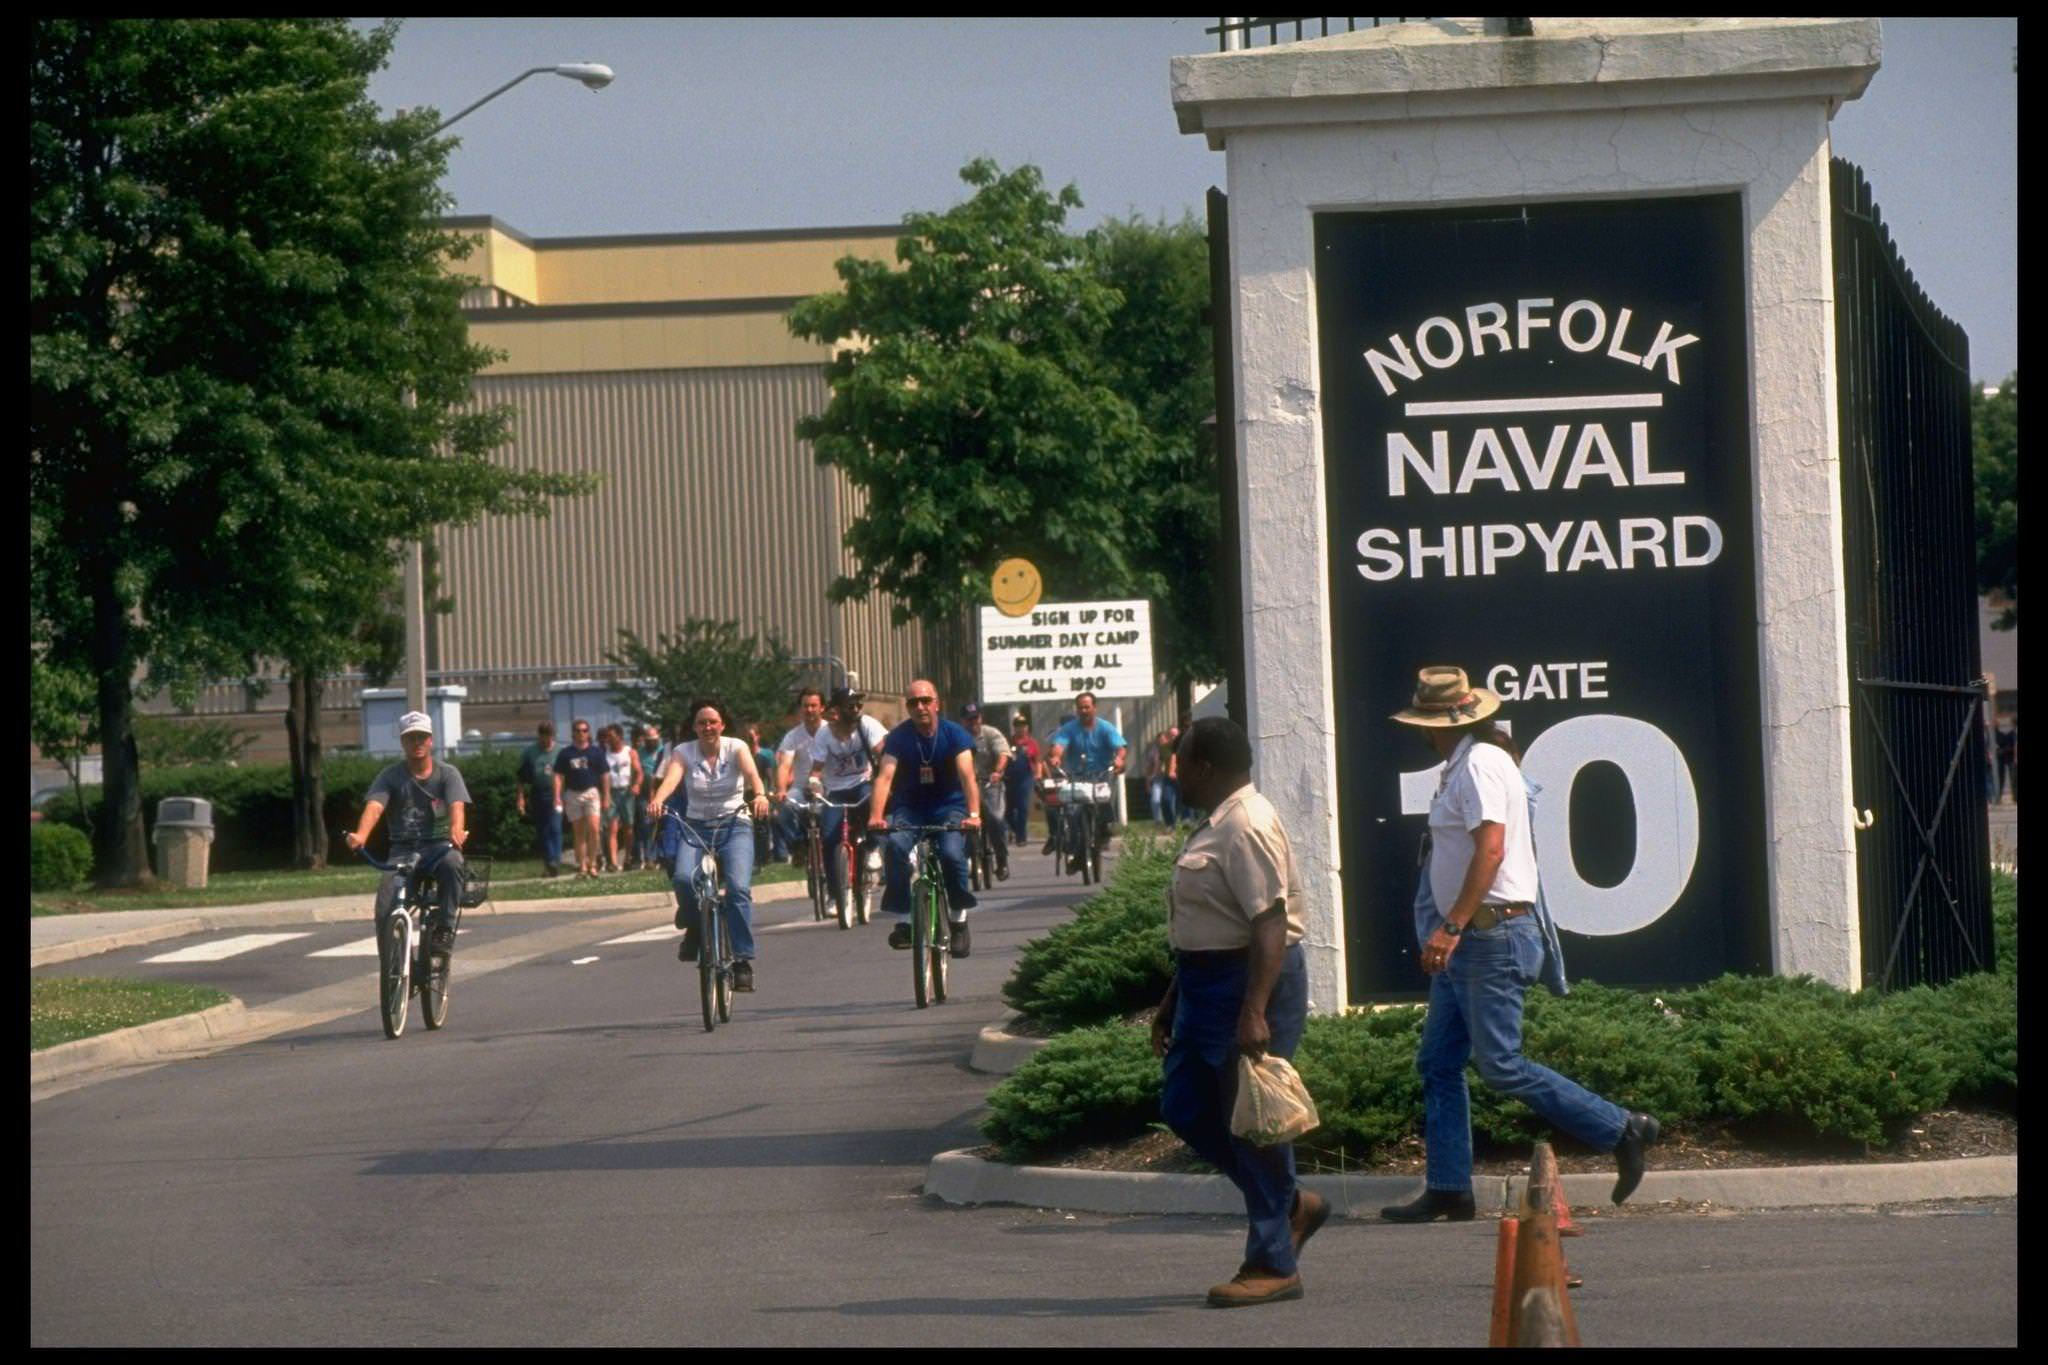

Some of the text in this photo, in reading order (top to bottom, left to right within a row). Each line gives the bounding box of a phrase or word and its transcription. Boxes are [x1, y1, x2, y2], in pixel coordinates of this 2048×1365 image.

[1363, 298, 1700, 396] NORFOLK
[1386, 421, 1686, 497] NAVAL
[1356, 515, 1723, 581] SHIPYARD
[1031, 608, 1136, 626] SIGN UP FOR
[987, 630, 1140, 650] SUMMER DAY CAMP
[1015, 653, 1124, 672] FUN FOR ALL
[1018, 676, 1107, 693] CALL 1990
[1486, 661, 1610, 702] GATE
